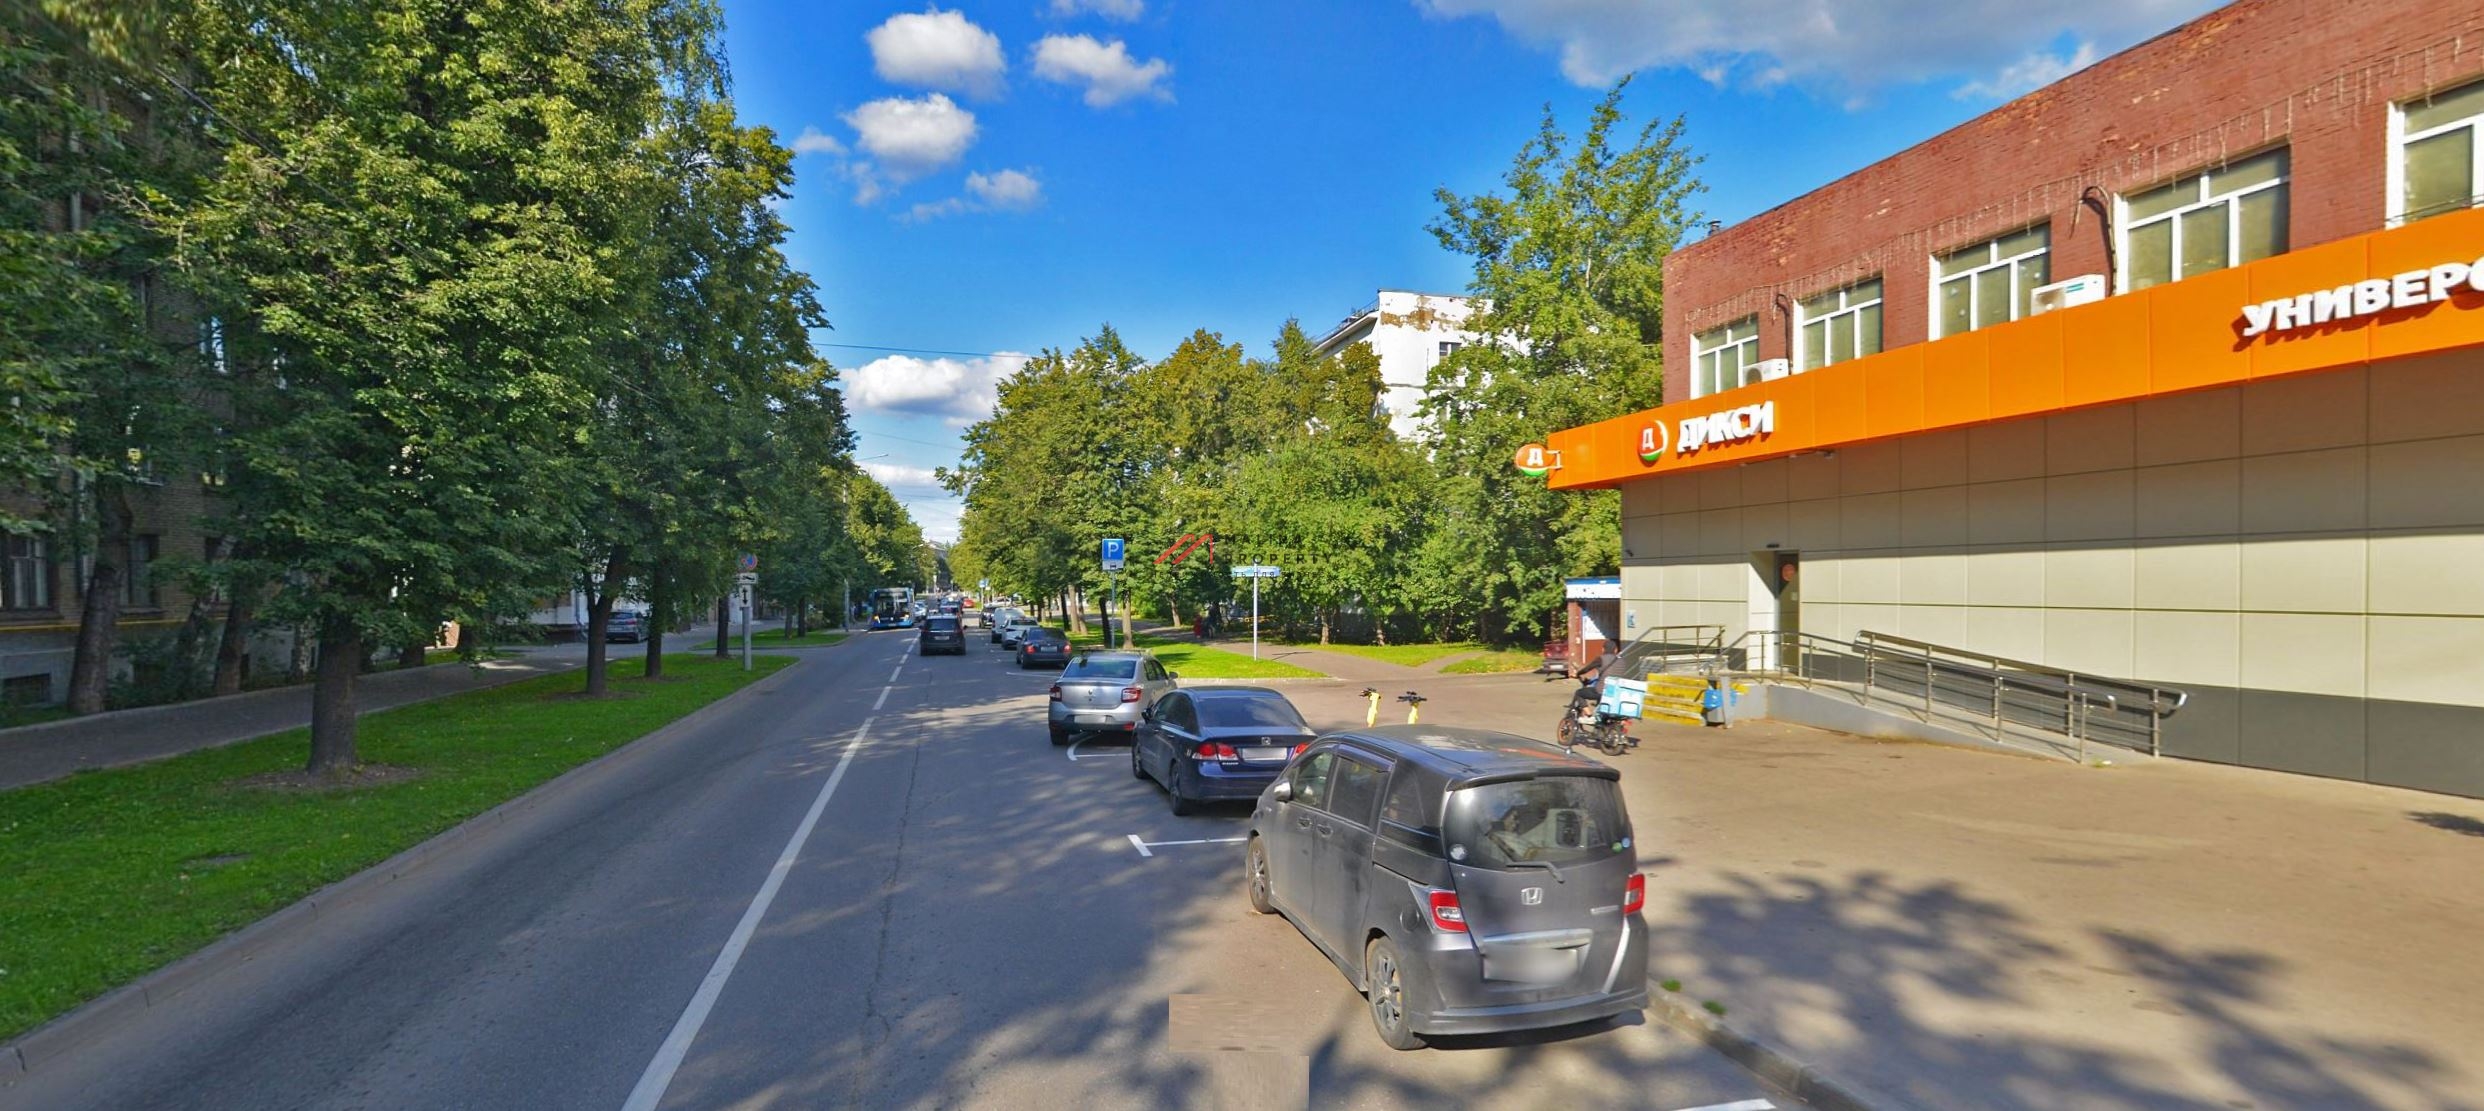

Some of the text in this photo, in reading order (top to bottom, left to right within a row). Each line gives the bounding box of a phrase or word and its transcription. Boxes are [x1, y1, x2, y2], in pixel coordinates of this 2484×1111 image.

[1677, 400, 1774, 453] ДИКСИ
[1641, 427, 1655, 449] Д
[1527, 447, 1544, 466] Д
[1108, 541, 1119, 558] P
